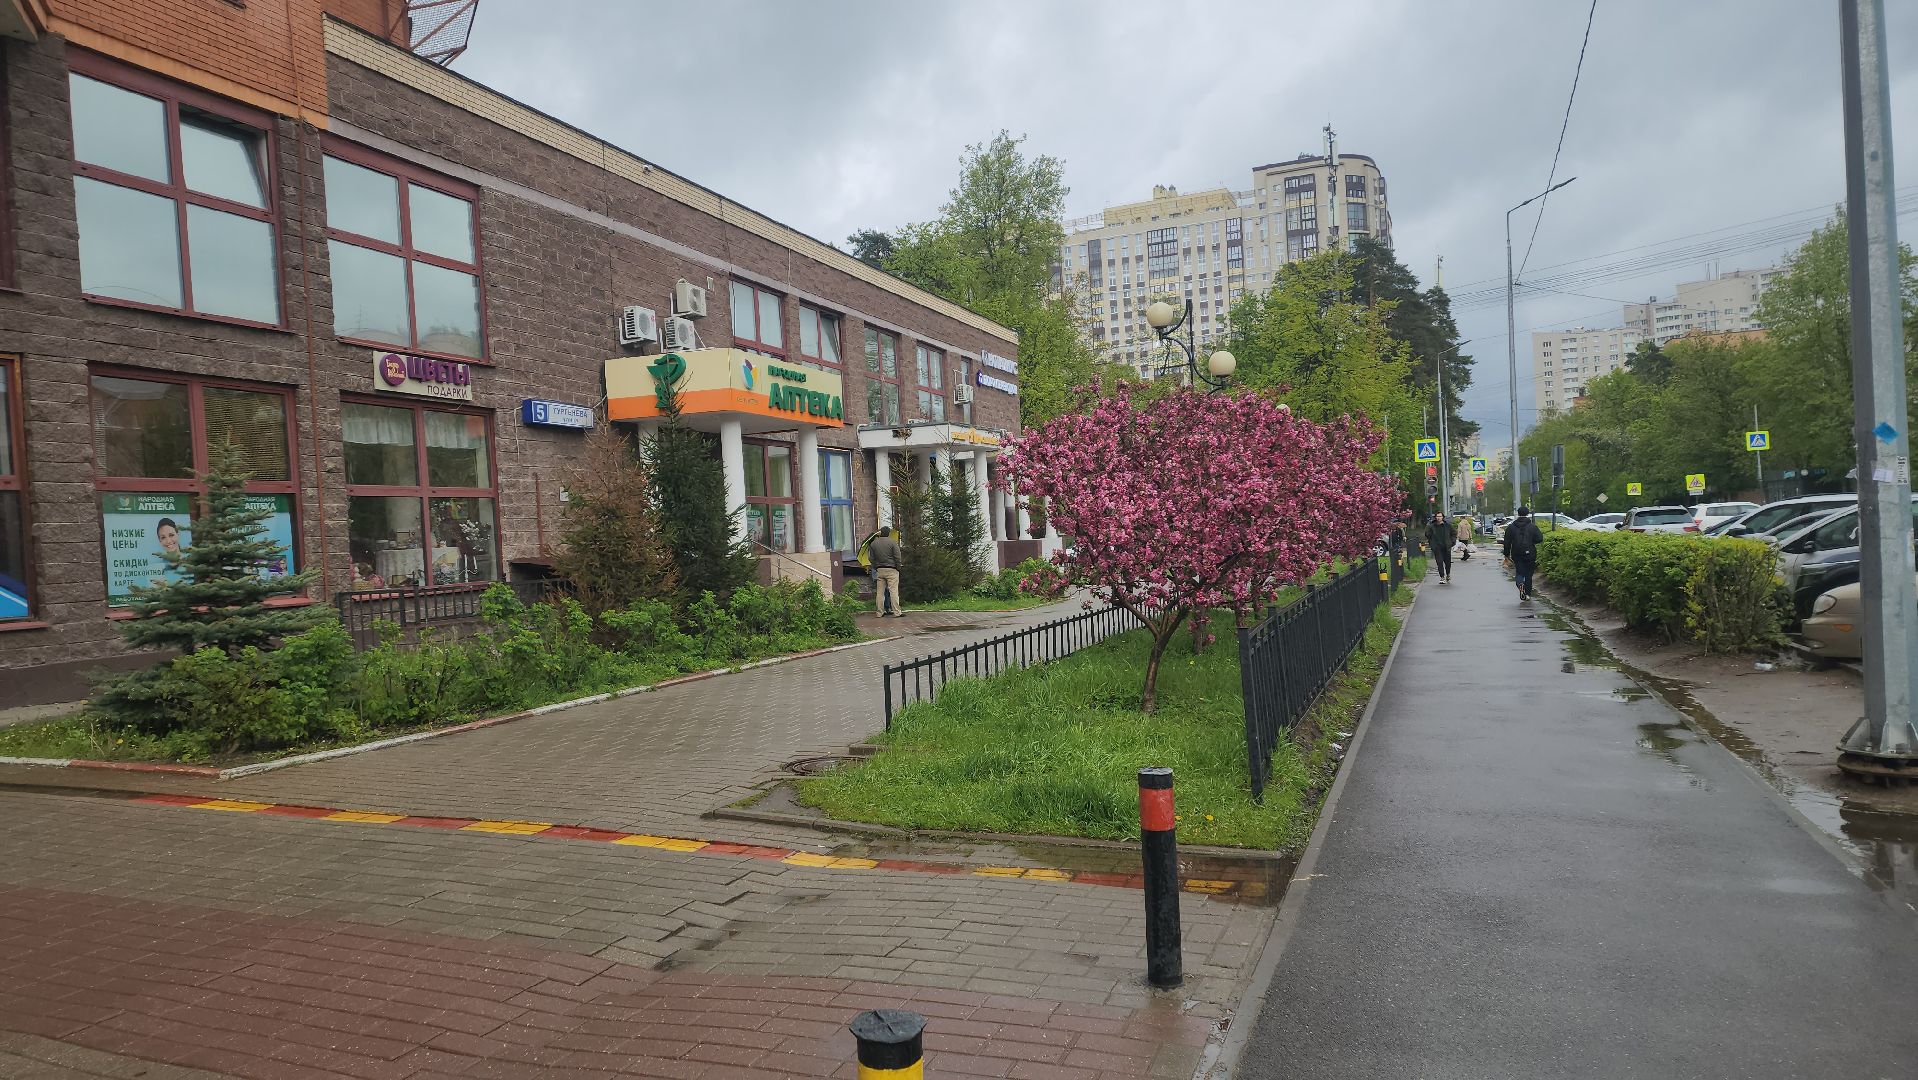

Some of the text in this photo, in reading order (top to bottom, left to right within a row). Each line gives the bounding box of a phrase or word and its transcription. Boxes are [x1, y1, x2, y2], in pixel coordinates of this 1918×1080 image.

[406, 355, 470, 386] ЦВЕТЫ
[427, 385, 468, 398] ПОДАРКИ
[768, 383, 844, 420] АПТЕКА
[536, 404, 545, 420] 5
[553, 407, 588, 418] ТУРГЕНЕВА
[138, 503, 176, 511] АПТЕКА
[244, 502, 277, 510] АПТЕКА
[111, 528, 145, 538] НИЗКИЕ
[112, 540, 138, 550] ЦЕНЫ
[113, 558, 149, 568] СКИДКИ
